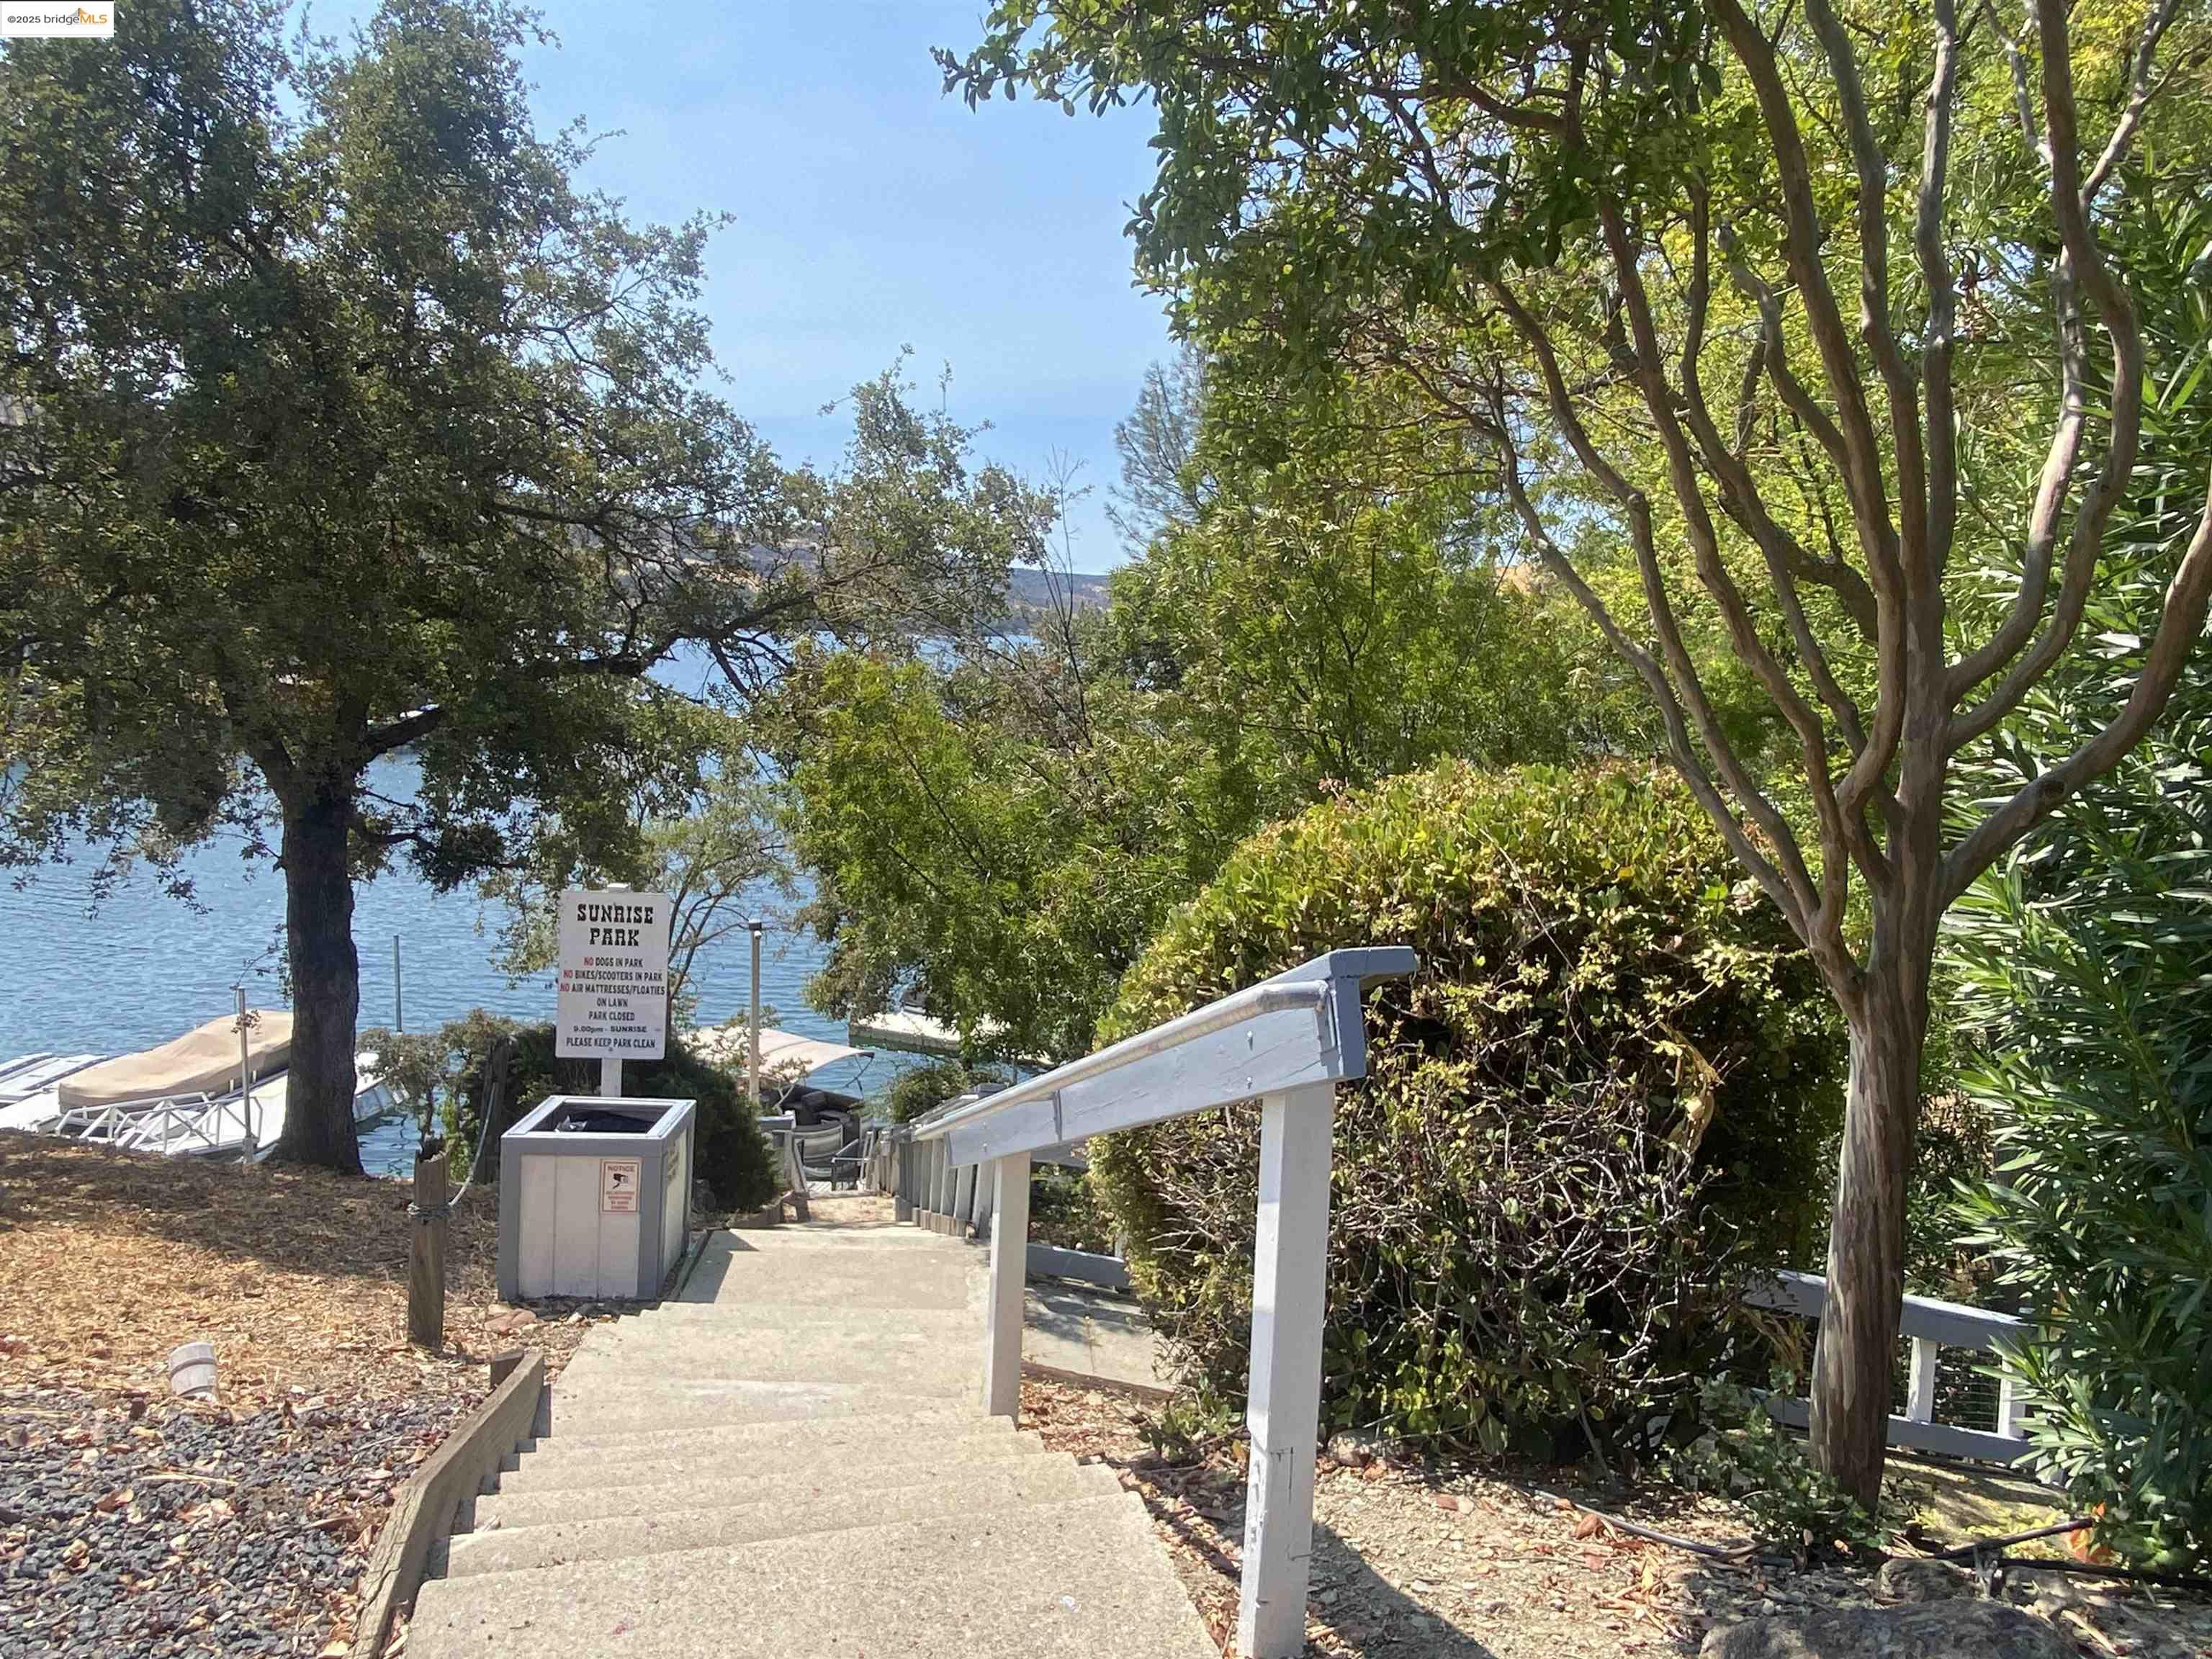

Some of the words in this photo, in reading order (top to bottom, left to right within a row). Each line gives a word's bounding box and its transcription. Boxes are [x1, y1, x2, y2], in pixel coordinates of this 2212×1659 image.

[577, 904, 654, 924] SUNRISE
[589, 927, 639, 947] PARK
[583, 957, 594, 966] NO
[595, 958, 614, 967] DOGS
[615, 958, 624, 967] IN
[624, 958, 643, 968] PARK
[563, 969, 573, 979] NO
[575, 970, 633, 981] BIKES/SCOOTERS
[635, 972, 643, 981] IN
[644, 972, 663, 981] PARK
[560, 983, 570, 992] NO
[571, 984, 583, 993] AIR
[585, 984, 665, 996] MATTRESSES/FLOATIES
[596, 998, 607, 1007] ON
[608, 998, 629, 1007] LAWN
[588, 1011, 607, 1020] PARK
[608, 1012, 635, 1021] CLOSED
[566, 1037, 592, 1047] PLEASE
[594, 1038, 611, 1047] KEEP
[613, 1038, 631, 1048] PARK
[633, 1039, 655, 1048] CLEAN
